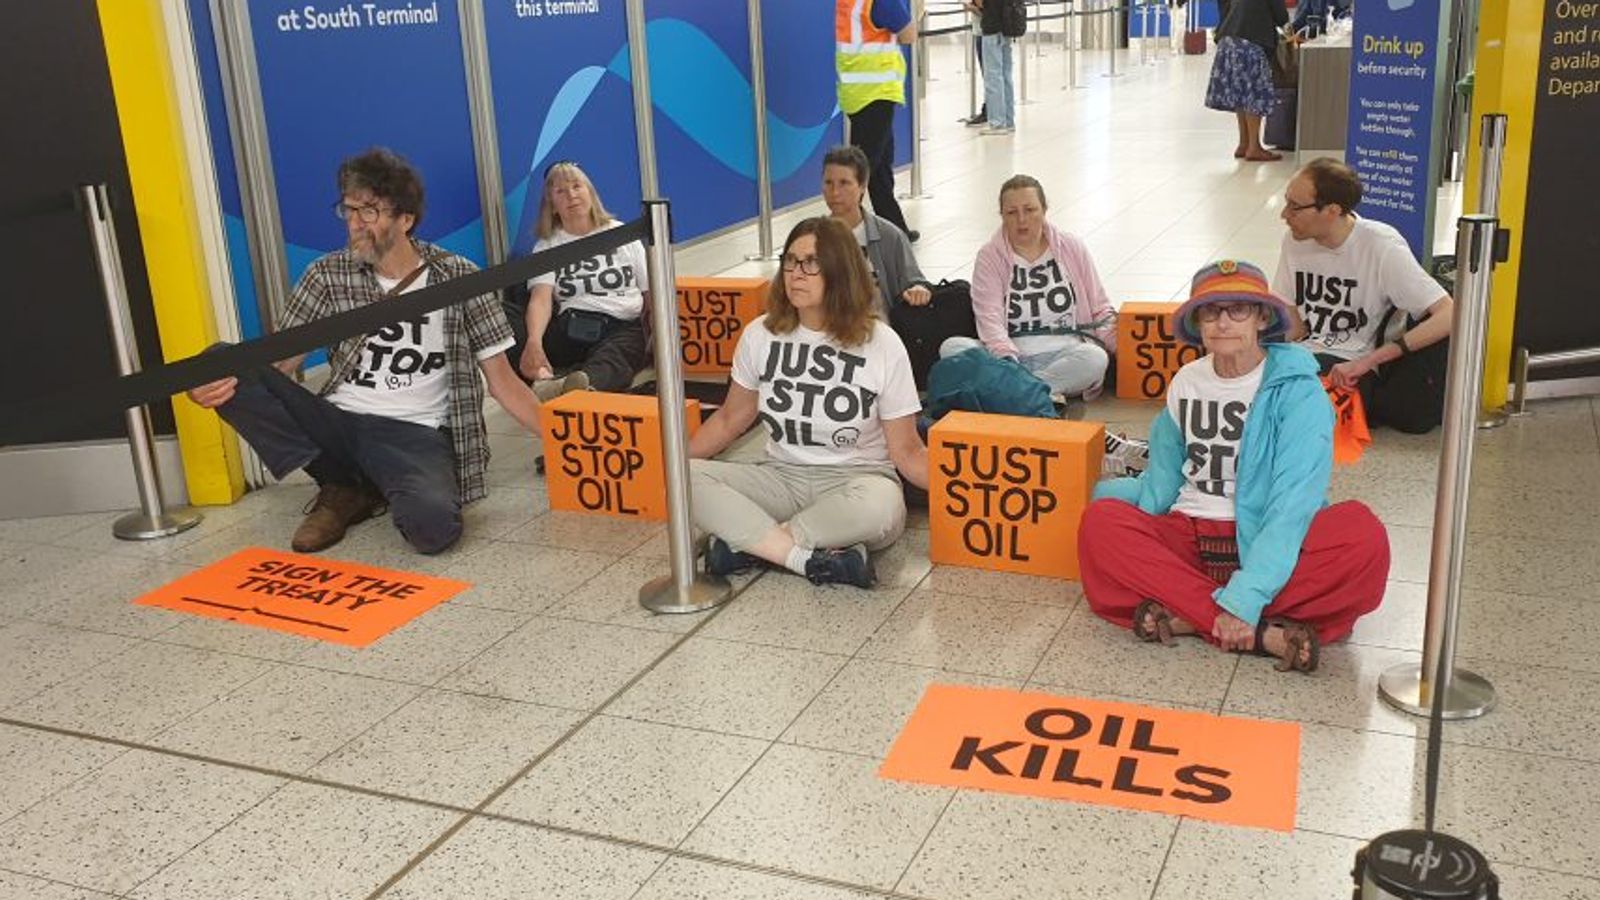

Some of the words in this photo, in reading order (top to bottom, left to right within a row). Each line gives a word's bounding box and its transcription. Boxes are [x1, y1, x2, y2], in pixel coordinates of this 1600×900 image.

[278, 10, 300, 31] at
[304, 5, 361, 29] South
[362, 2, 438, 26] Terminal
[516, 0, 542, 18] this
[545, 0, 599, 16] terminal
[1556, 1, 1599, 18] Over
[1363, 35, 1401, 54] Drink
[1405, 41, 1424, 59] up
[1553, 25, 1587, 45] and
[1358, 62, 1387, 75] before
[1389, 64, 1427, 79] security
[555, 247, 617, 282] UST
[559, 265, 633, 297] STOP
[1011, 258, 1063, 291] UST
[676, 290, 741, 315] UST
[1007, 283, 1076, 319] STO
[1295, 271, 1358, 306] JUST
[368, 316, 430, 345] ST
[678, 316, 741, 340] STOP
[1131, 314, 1175, 341] JU
[357, 341, 446, 375] TOP
[682, 341, 733, 366] OIL
[759, 341, 866, 384] JUST
[1136, 342, 1206, 370] STO
[766, 379, 878, 420] STOP
[551, 410, 643, 447] JUST
[1180, 398, 1253, 441] JUS
[562, 443, 643, 480] STOP
[940, 441, 1059, 487] JUST
[1186, 442, 1239, 480] ST
[577, 477, 639, 515] OIL
[946, 479, 1057, 524] STOP
[963, 518, 1030, 562] OIL
[237, 576, 382, 611] TREATY
[249, 561, 342, 584] SIGN
[344, 575, 424, 599] THE
[1024, 708, 1180, 756] OIL
[950, 736, 1232, 804] KILLS
